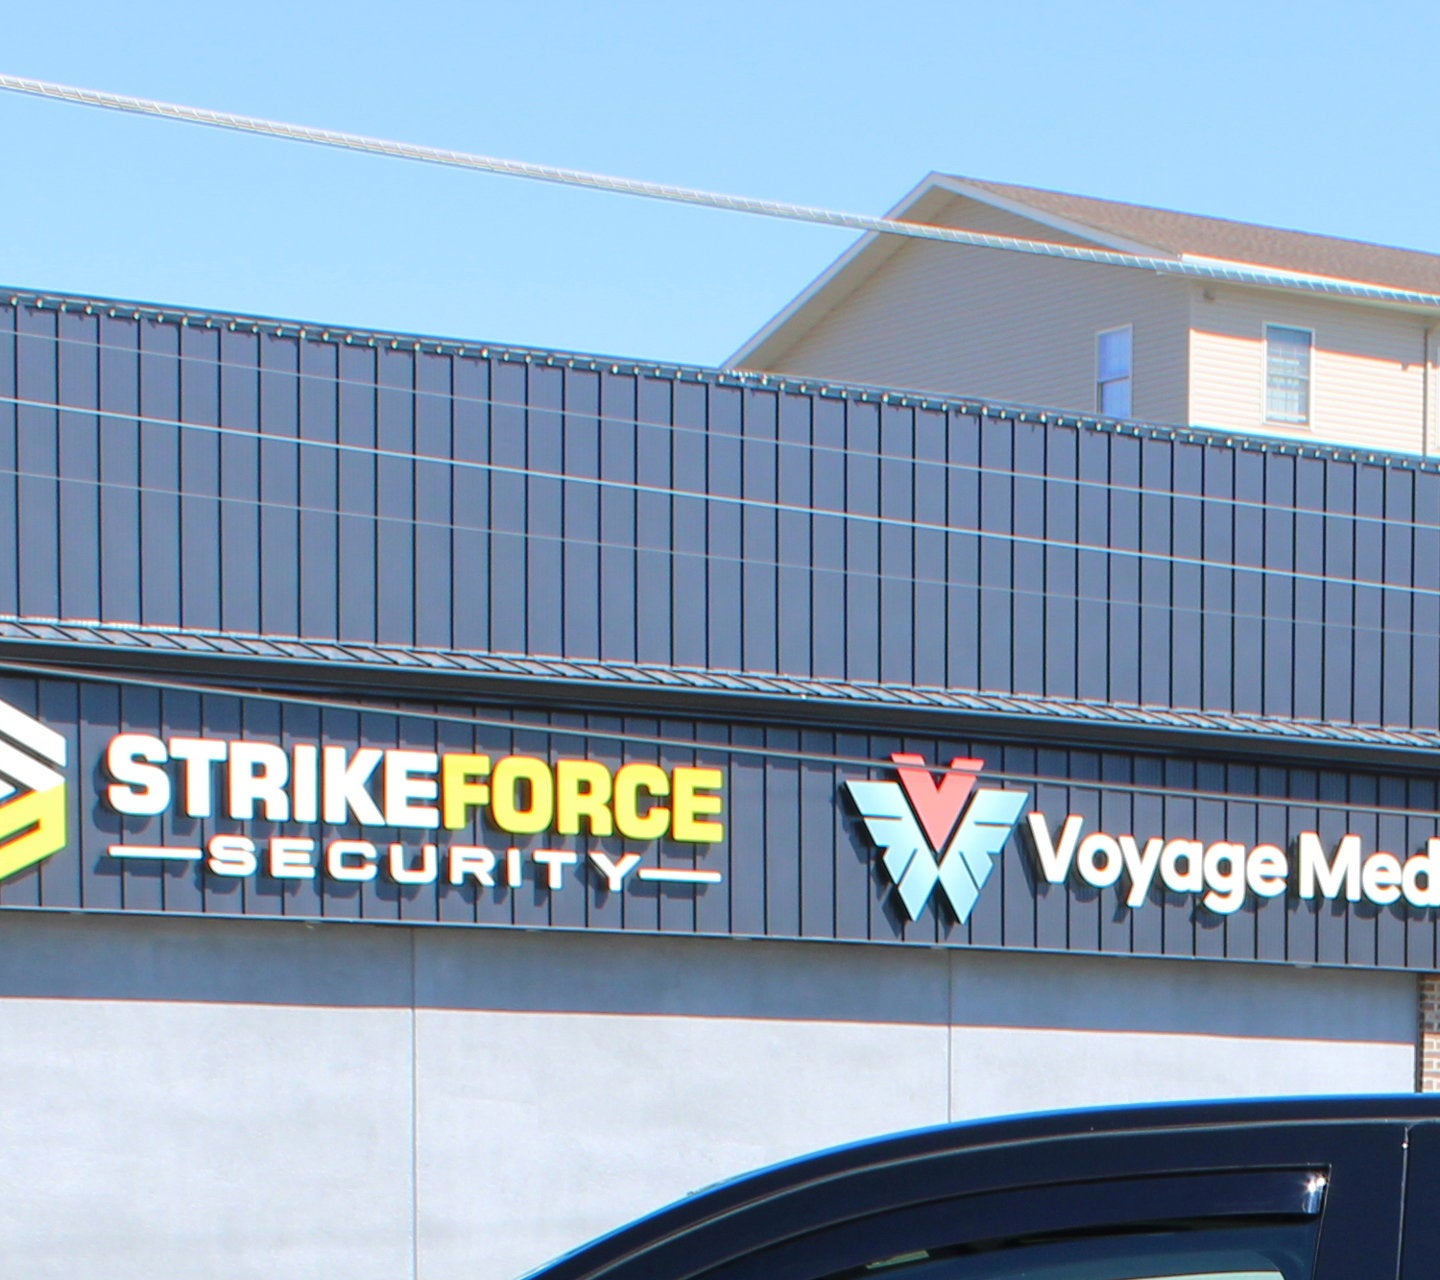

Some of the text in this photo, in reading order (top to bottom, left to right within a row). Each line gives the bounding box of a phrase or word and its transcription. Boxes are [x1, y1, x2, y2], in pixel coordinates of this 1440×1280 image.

[107, 733, 724, 842] STRIKEFORCE
[208, 834, 642, 891] SECURITY
[1028, 811, 1288, 915] Voyage
